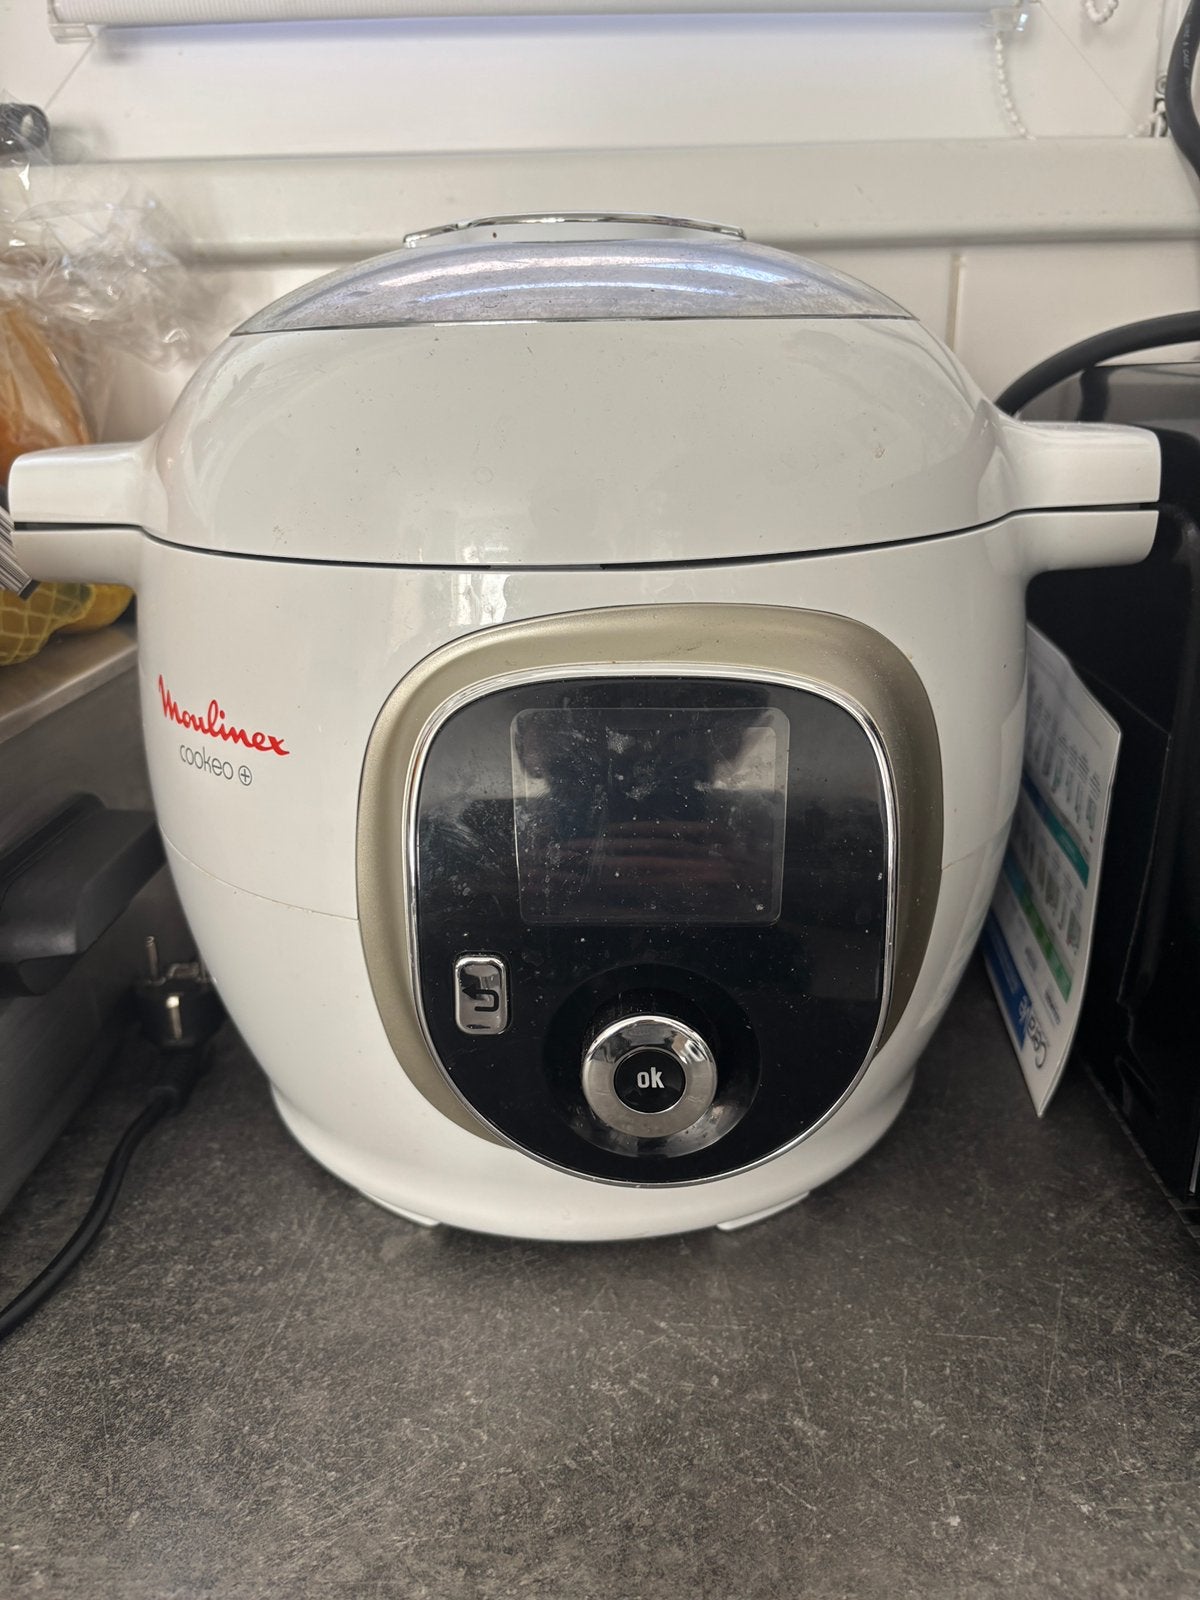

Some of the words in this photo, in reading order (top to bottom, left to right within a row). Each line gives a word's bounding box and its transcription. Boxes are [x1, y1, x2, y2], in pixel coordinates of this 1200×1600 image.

[158, 673, 290, 756] Moulinex
[179, 744, 234, 780] cookeo
[636, 1066, 665, 1089] ok
